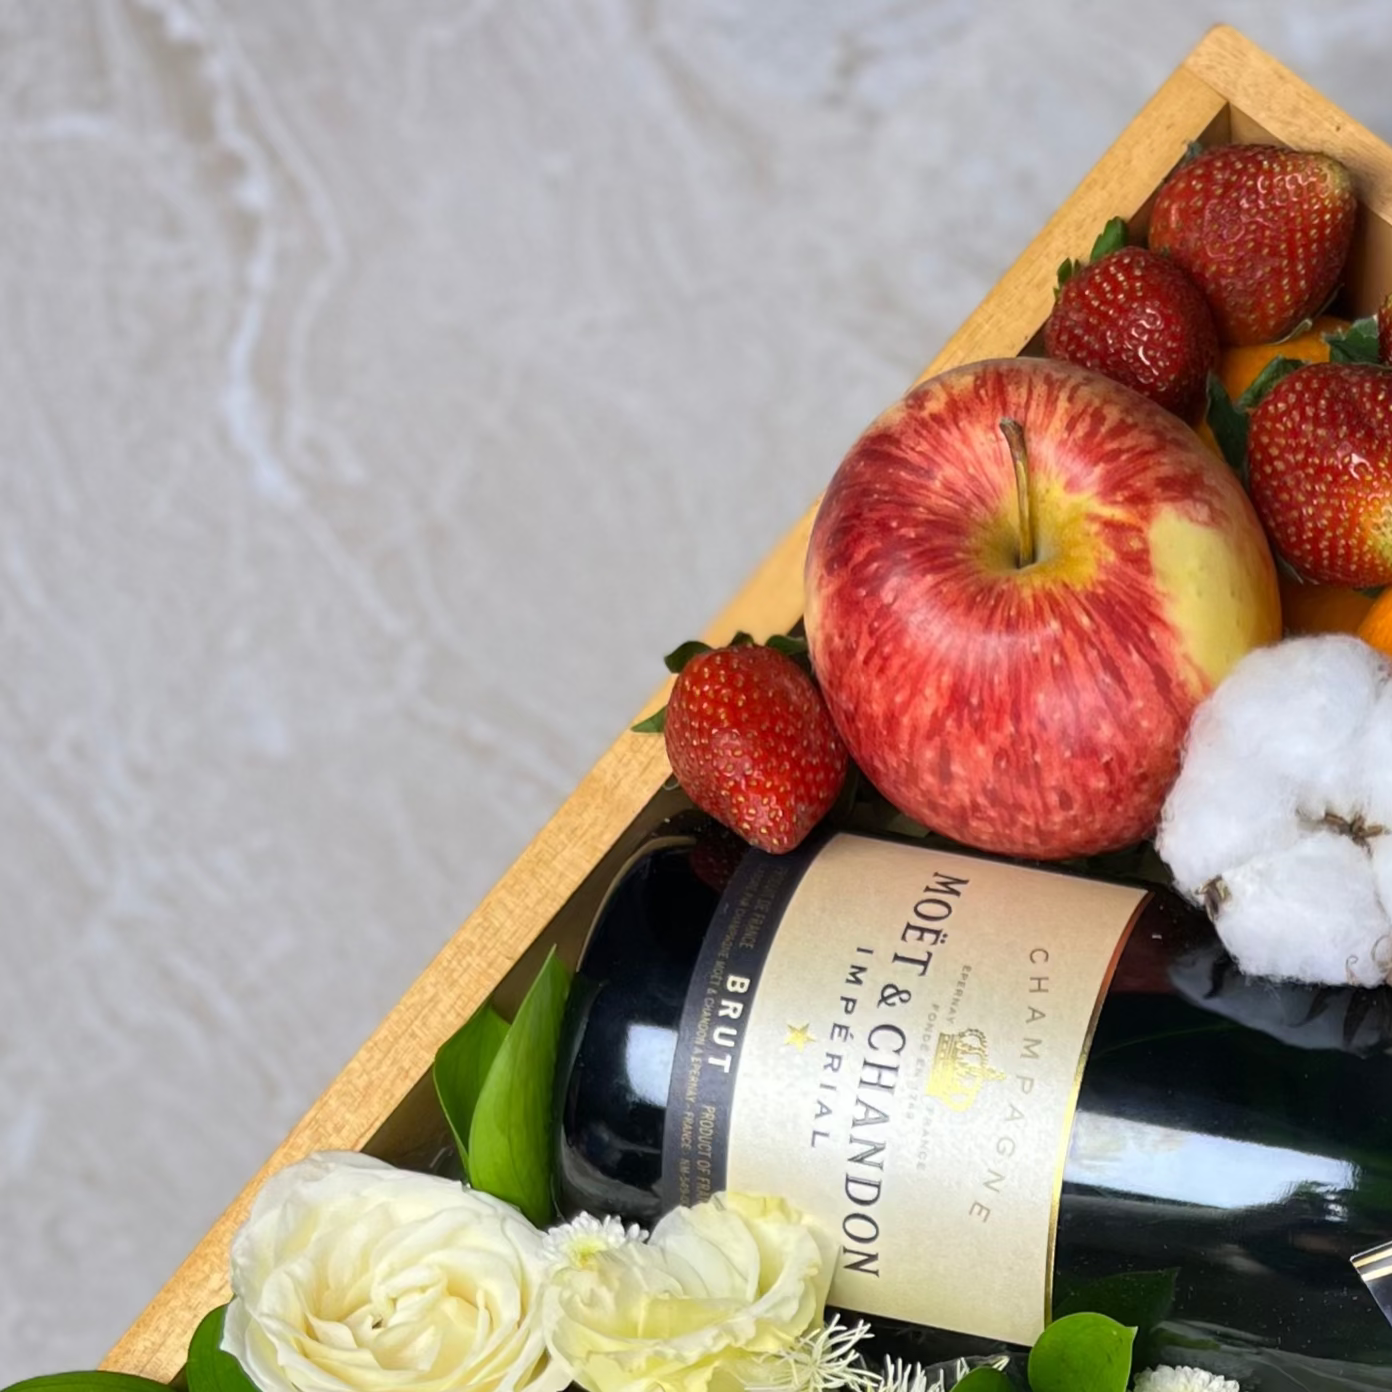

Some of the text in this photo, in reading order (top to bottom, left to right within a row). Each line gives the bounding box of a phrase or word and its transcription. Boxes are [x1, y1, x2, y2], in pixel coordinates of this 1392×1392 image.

[717, 907, 747, 959] CHAMPAGNE
[740, 911, 766, 949] FRANCE
[695, 997, 714, 1046] CHANDON
[708, 974, 751, 1073] BRUT
[810, 946, 874, 1149] IMPÉRIAL
[842, 871, 970, 1278] MOËT & CHANDON
[968, 946, 1050, 1223] CHAMPAGNE
[680, 1110, 694, 1150] FRANCE
[697, 1104, 716, 1158] PRODUCT
[916, 1105, 935, 1173] FRANCE
[696, 1160, 711, 1174] OF
